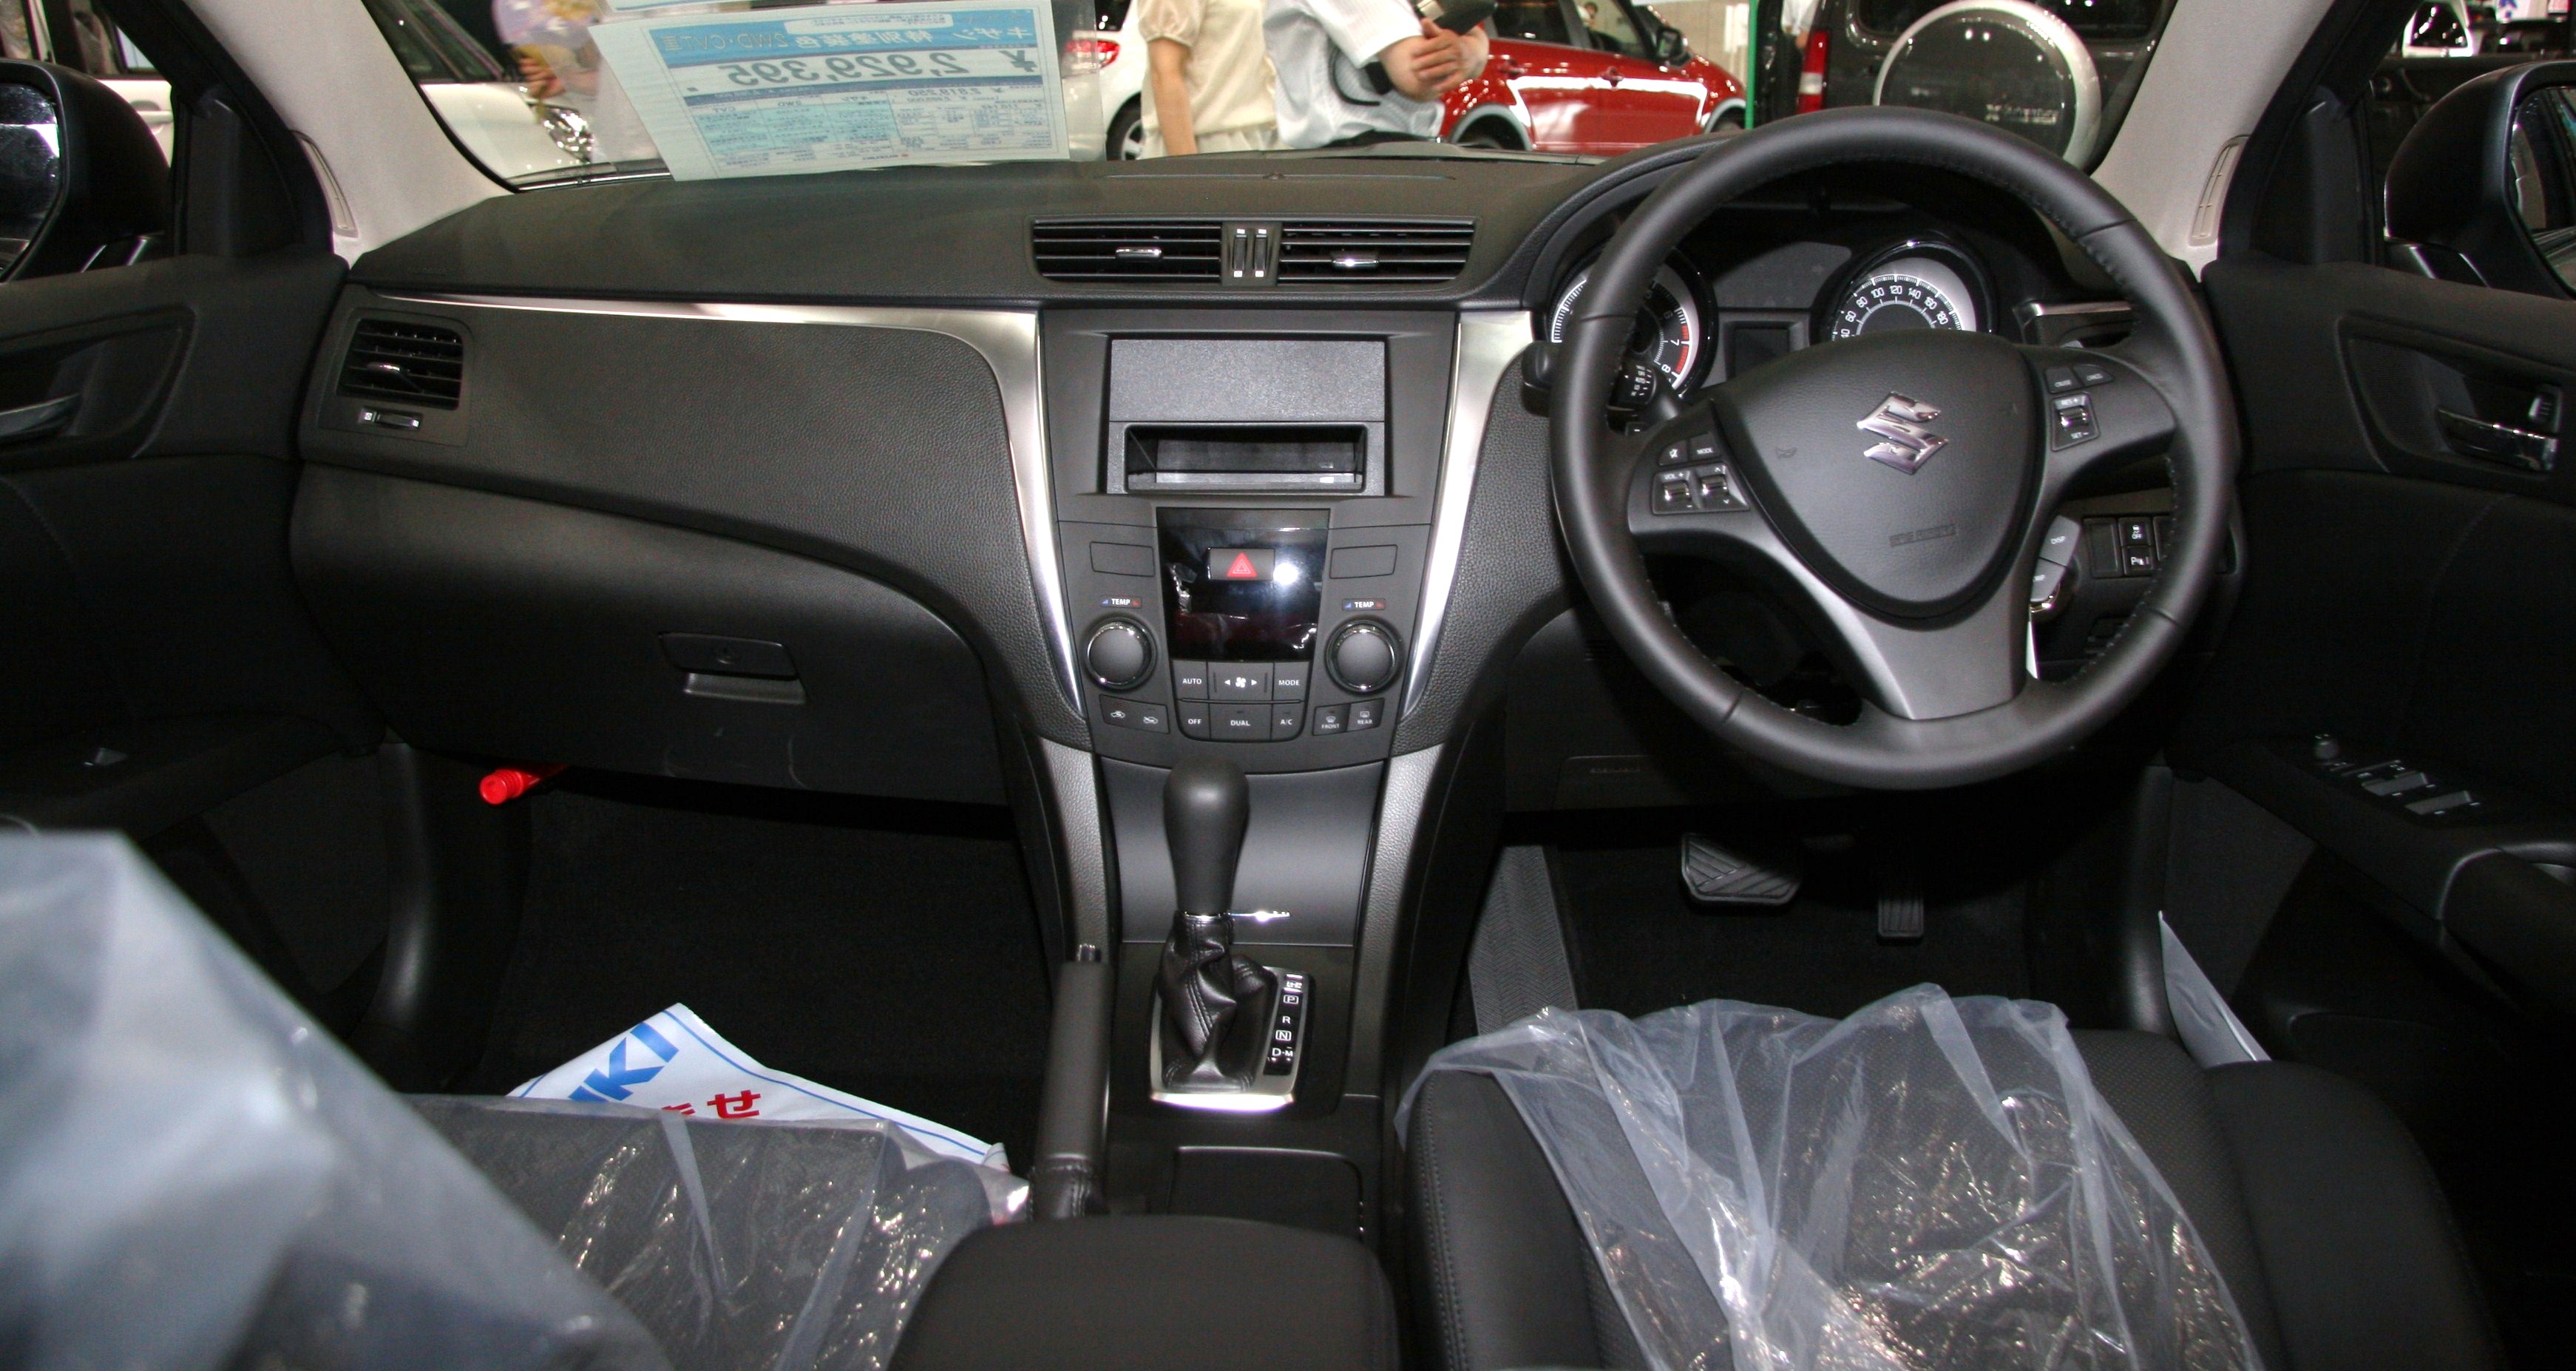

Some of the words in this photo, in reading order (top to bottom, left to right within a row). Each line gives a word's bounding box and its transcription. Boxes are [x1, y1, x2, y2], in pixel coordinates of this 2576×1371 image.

[1871, 287, 1885, 298] 100
[1889, 285, 1903, 294] 120
[1908, 288, 1922, 299] 140
[1856, 297, 1868, 308] 80
[1845, 311, 1857, 322] 60
[1661, 364, 1671, 373] 8
[2050, 535, 2066, 545] DISP
[1111, 598, 1131, 606] TEMP
[1354, 600, 1375, 609] TEMP
[1282, 1016, 1291, 1024] R
